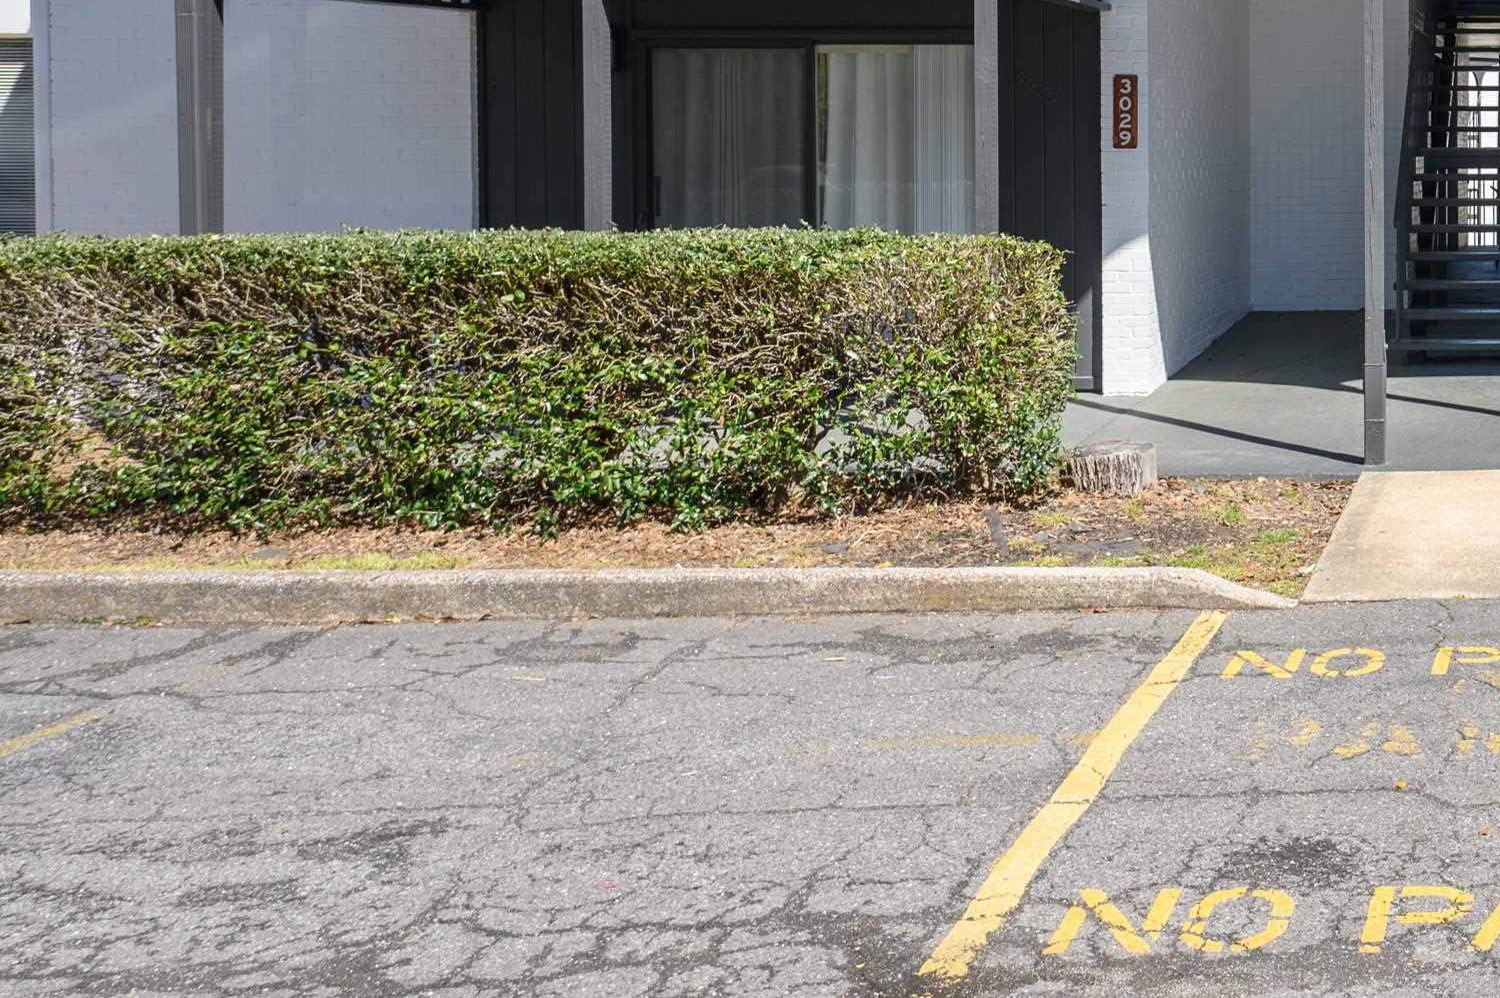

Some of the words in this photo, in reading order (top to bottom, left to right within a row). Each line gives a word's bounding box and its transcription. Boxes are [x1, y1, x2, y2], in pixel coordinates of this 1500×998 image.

[1119, 78, 1132, 145] 3029
[1216, 648, 1387, 680] NO
[1041, 885, 1296, 955] NO
